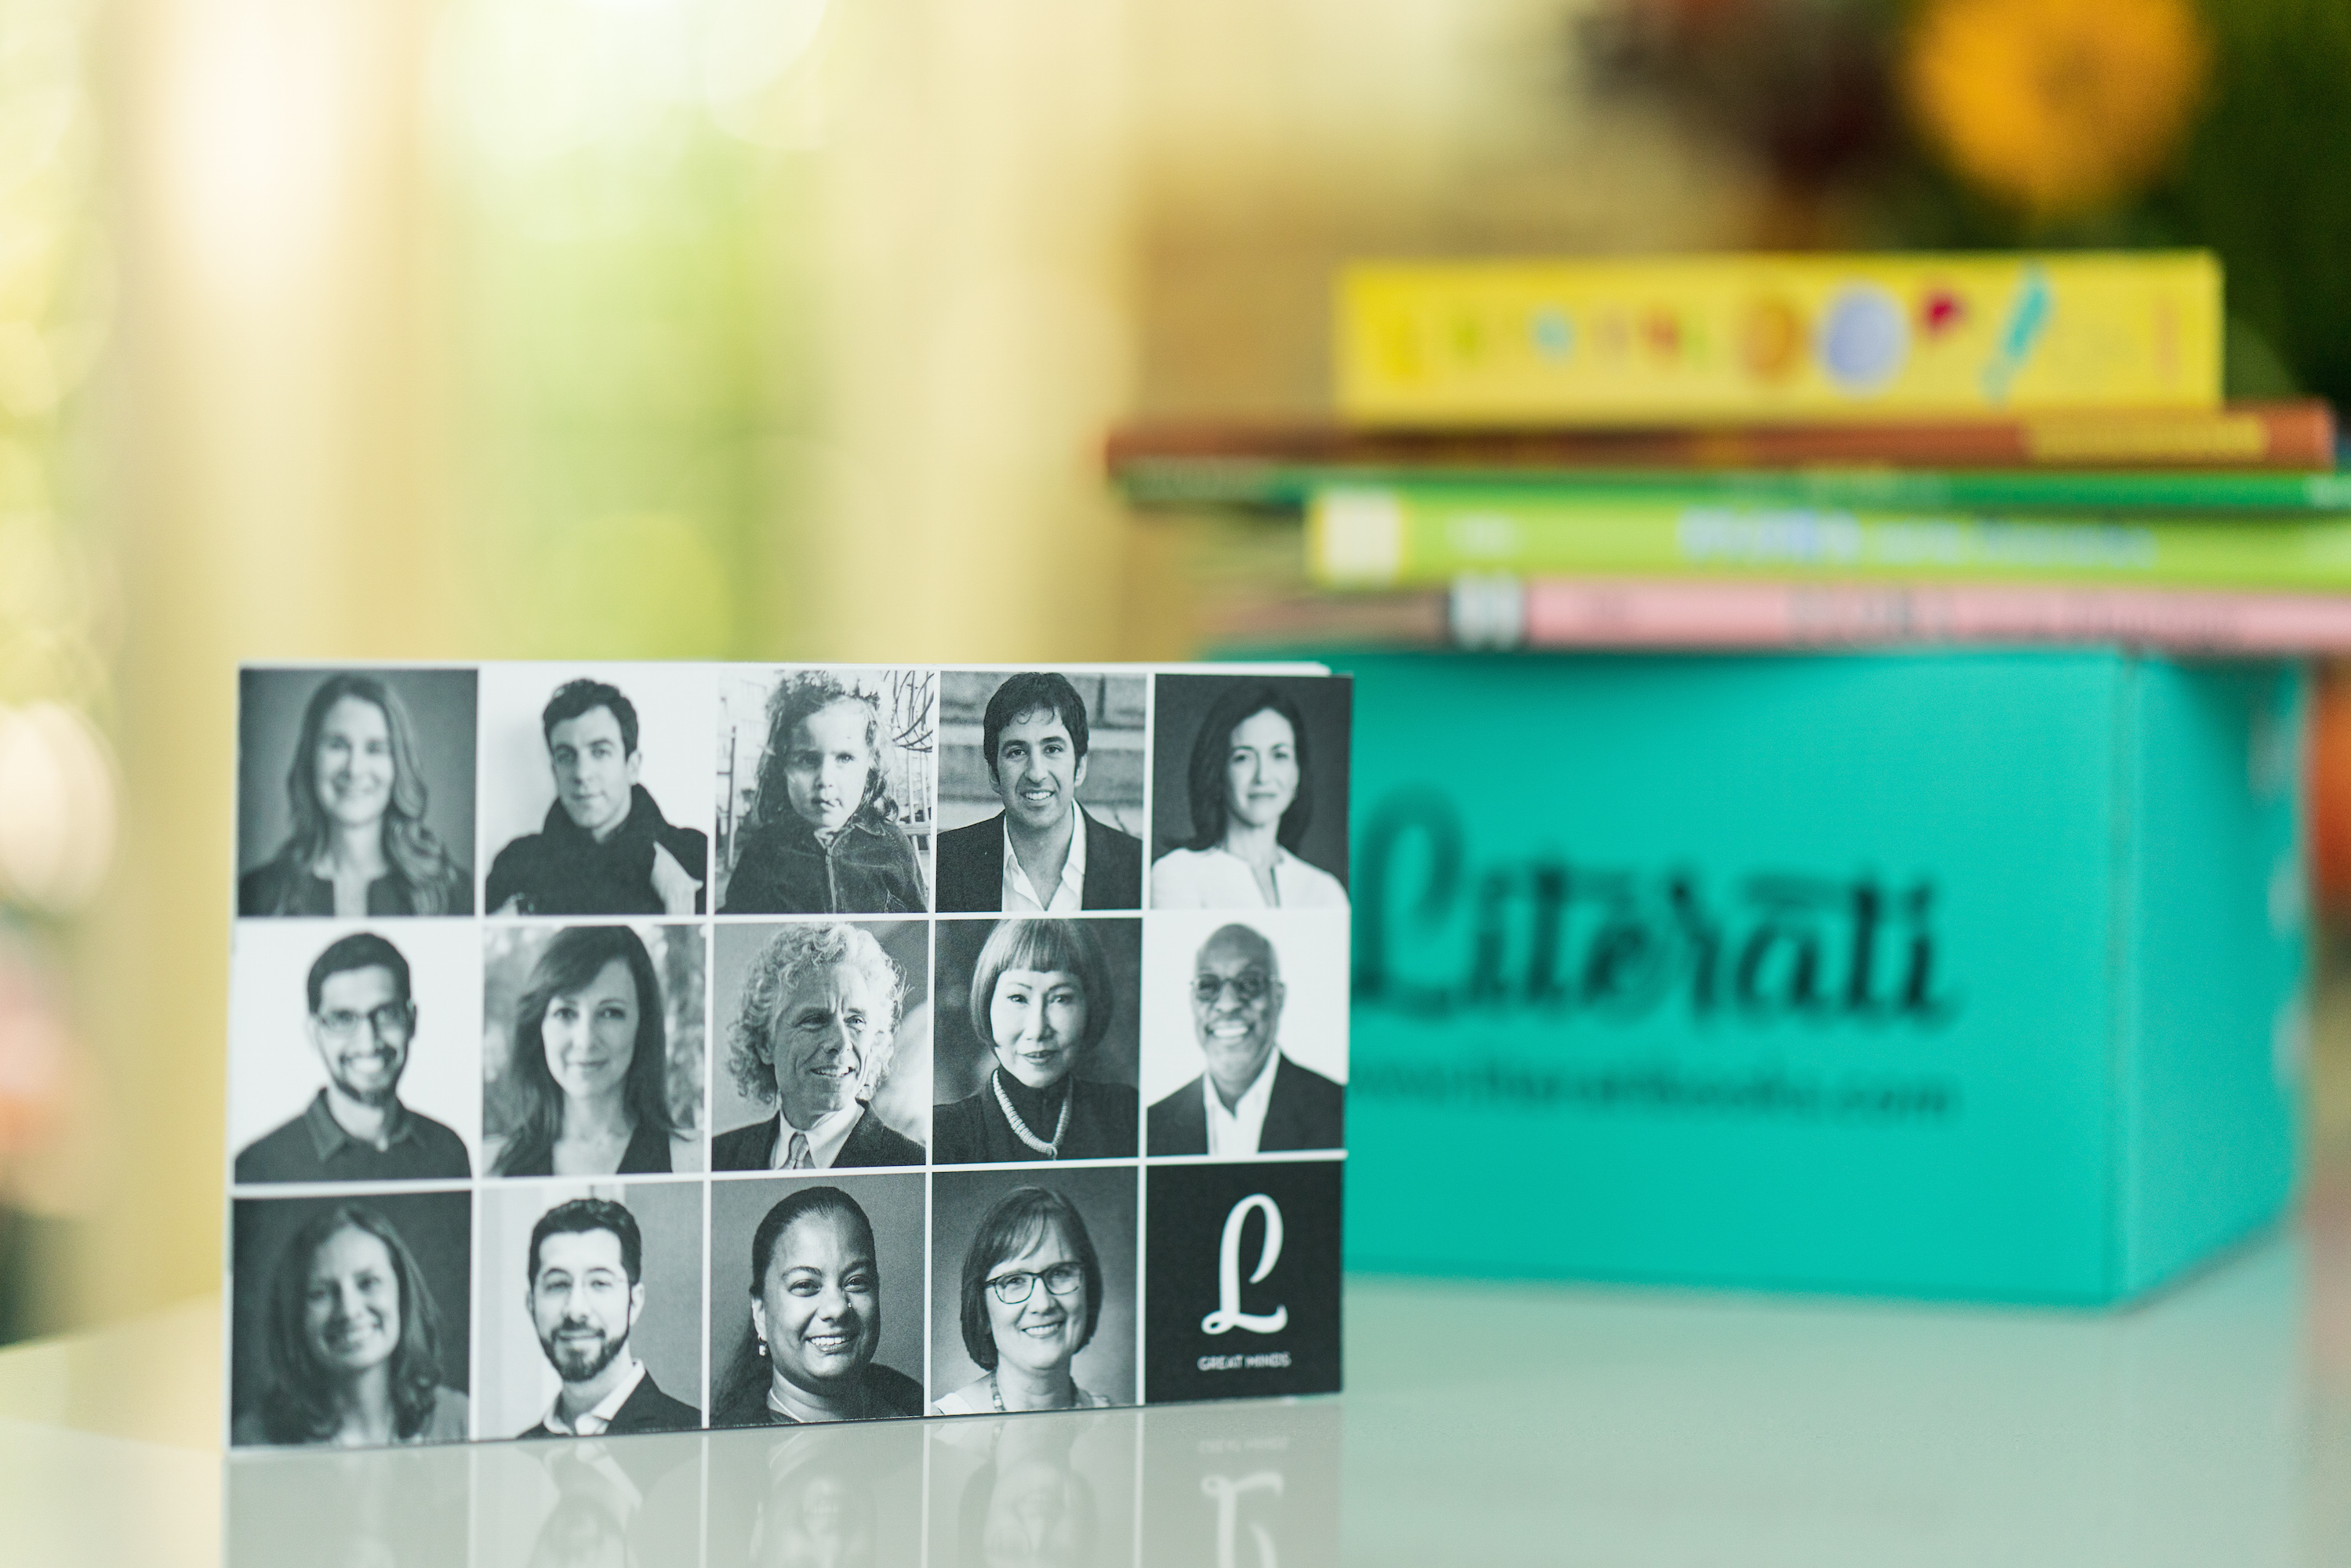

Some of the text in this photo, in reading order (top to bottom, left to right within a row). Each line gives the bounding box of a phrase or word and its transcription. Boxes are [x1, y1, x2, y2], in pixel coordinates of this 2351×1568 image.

[1201, 1192, 1288, 1334] L
[1197, 1351, 1292, 1371] GREAT MINDS
